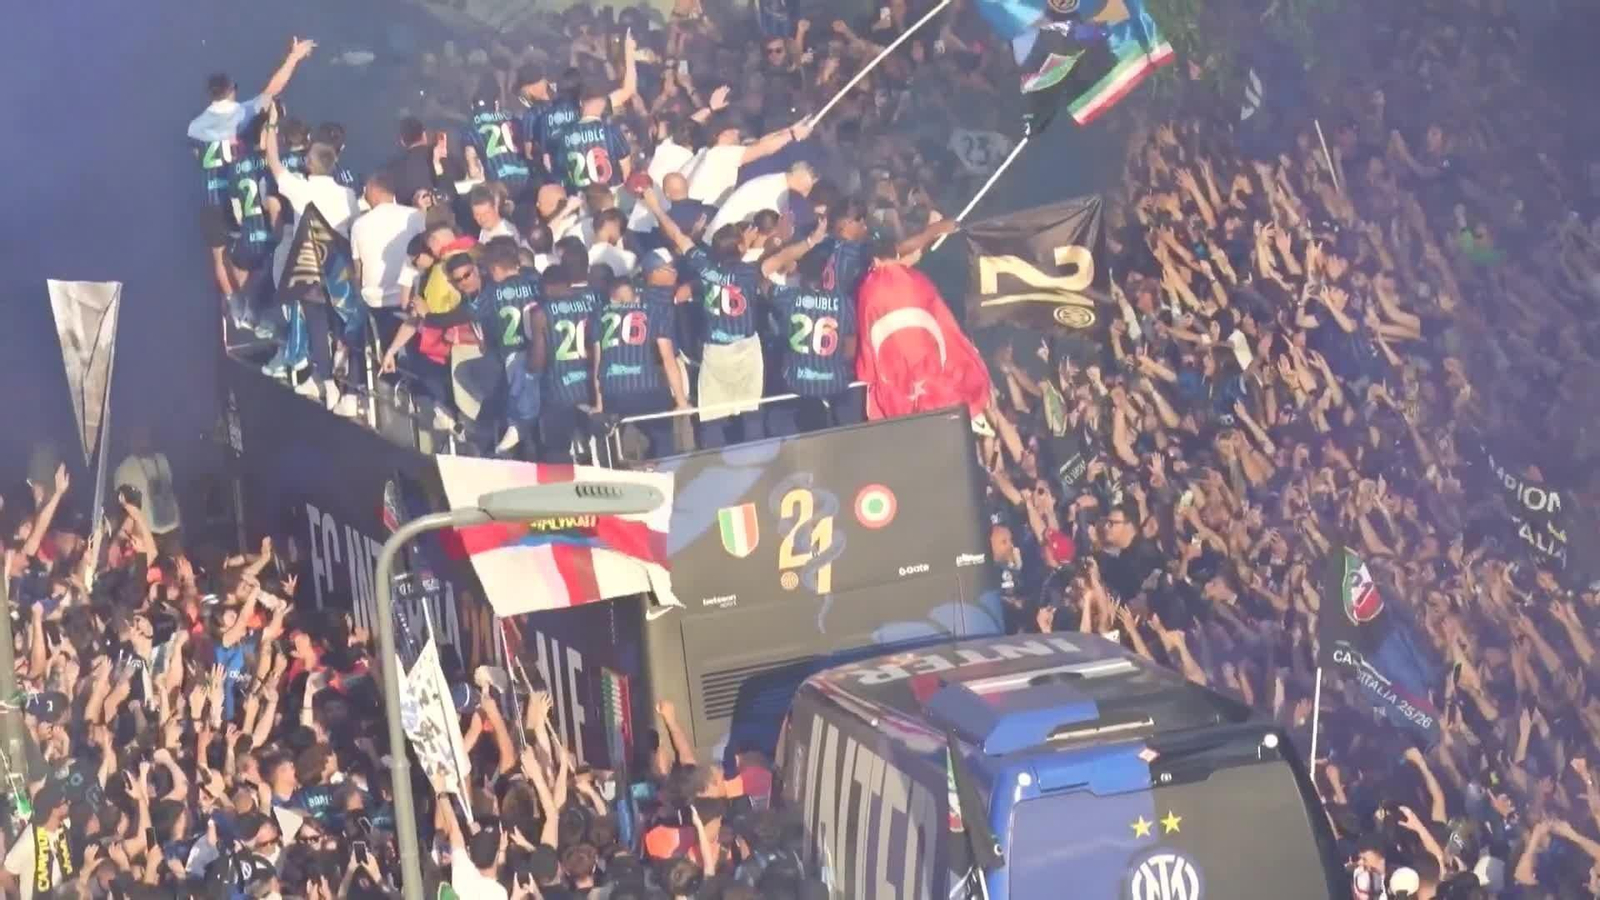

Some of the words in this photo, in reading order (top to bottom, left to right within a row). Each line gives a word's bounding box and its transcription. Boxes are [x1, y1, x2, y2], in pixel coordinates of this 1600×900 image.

[567, 147, 612, 187] 26
[601, 311, 648, 350] 26
[789, 313, 838, 357] 26
